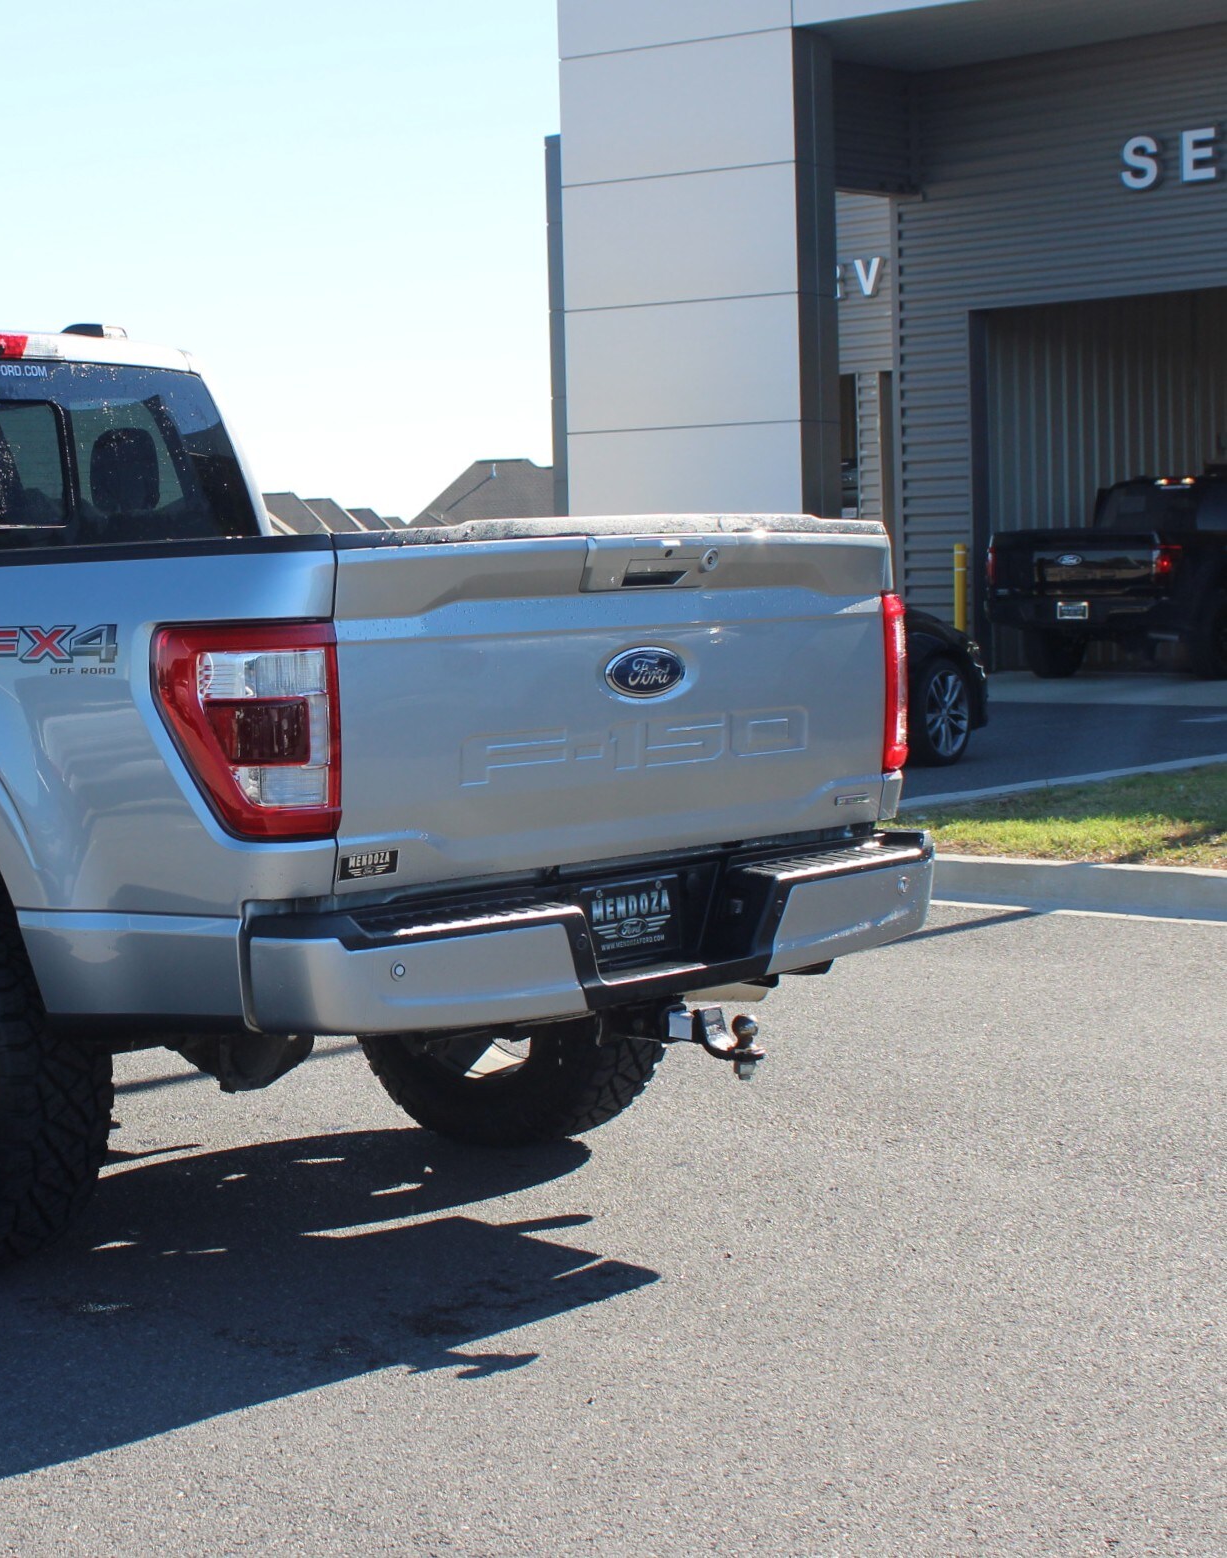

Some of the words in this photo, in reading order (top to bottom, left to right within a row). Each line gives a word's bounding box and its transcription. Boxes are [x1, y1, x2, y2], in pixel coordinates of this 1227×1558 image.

[50, 667, 75, 675] OFF
[81, 667, 116, 675] ROAD
[628, 657, 671, 687] Ford
[460, 706, 809, 788] F-150
[348, 851, 390, 869] MENDOZA
[591, 889, 671, 922] MENDOZA
[621, 920, 643, 936] Ford
